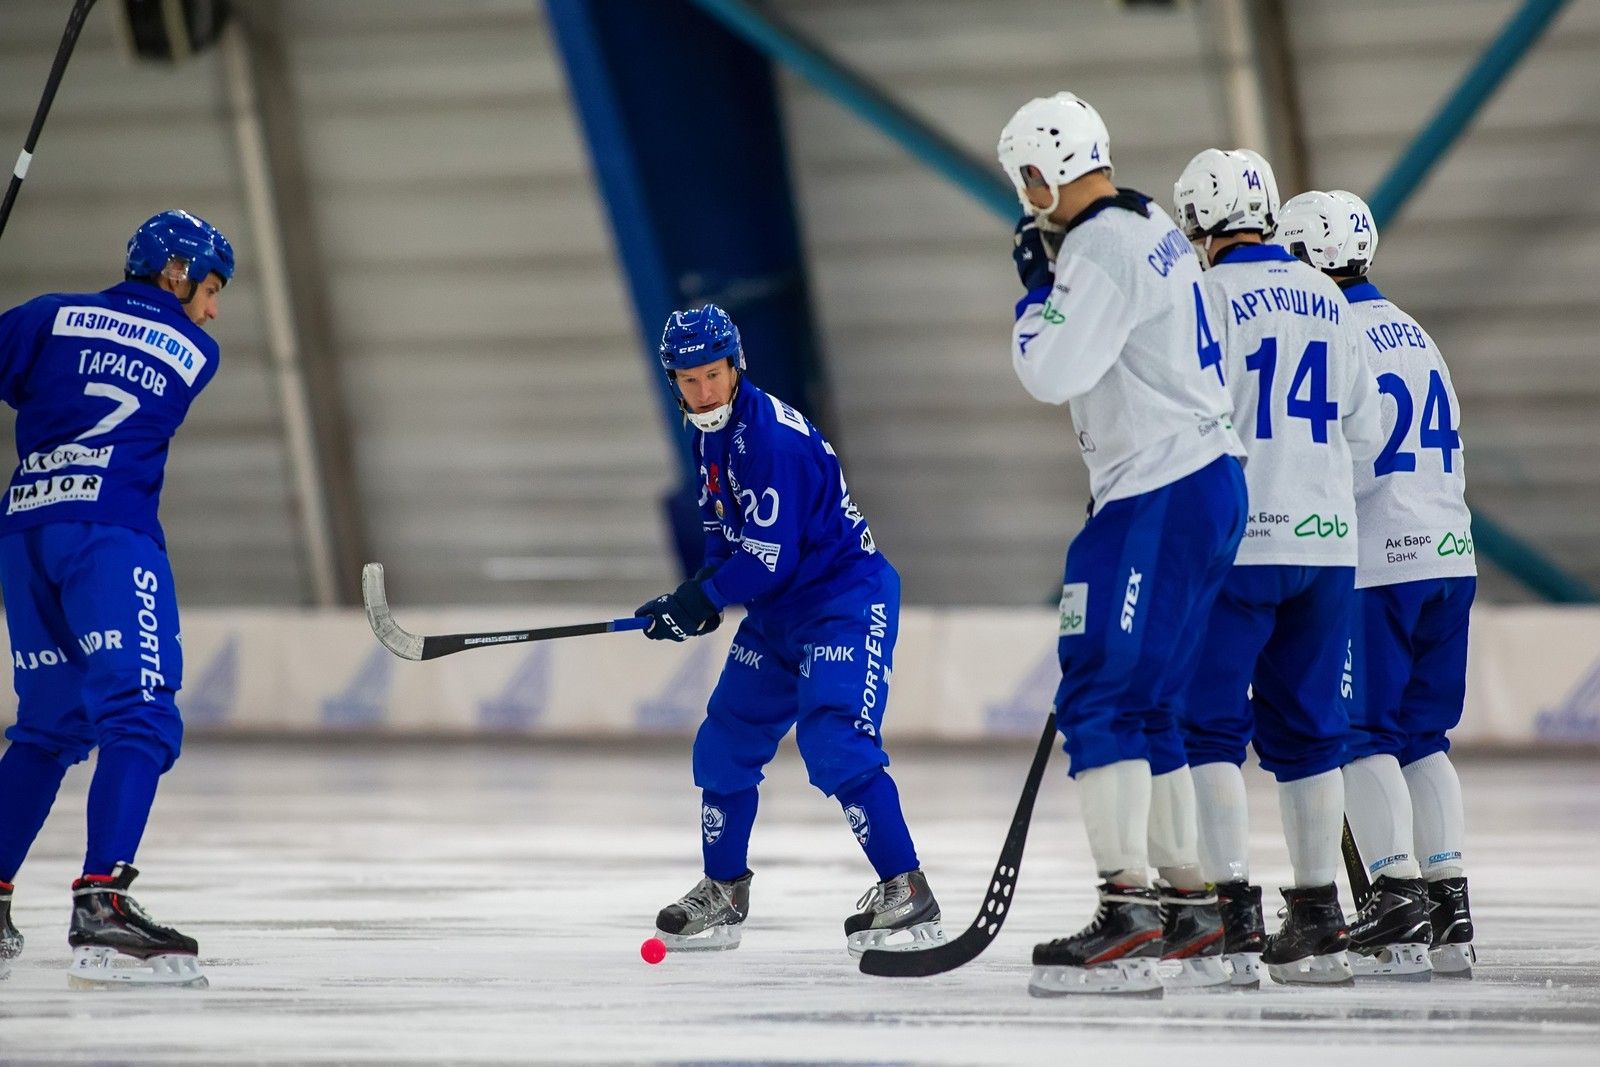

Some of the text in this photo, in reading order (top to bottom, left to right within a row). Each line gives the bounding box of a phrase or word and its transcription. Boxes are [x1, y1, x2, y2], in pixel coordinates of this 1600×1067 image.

[1090, 142, 1100, 162] 4
[1242, 169, 1262, 191] 14
[1284, 228, 1304, 237] CCM
[1349, 212, 1369, 233] 24
[1231, 286, 1339, 326] АРТЮШИН
[66, 311, 194, 371] ГАЗПРОМНЕФТЬ
[678, 343, 706, 354] CCM
[1192, 281, 1226, 387] 4
[1366, 321, 1427, 353] КОРЕВ
[78, 348, 168, 397] ТАРАСОВ
[1245, 336, 1339, 444] 14
[83, 381, 142, 442] 7
[1373, 369, 1461, 478] 24
[12, 476, 99, 503] MAJOR
[1259, 512, 1290, 524] Барс
[1385, 535, 1432, 549] Ак Барс
[1387, 551, 1418, 563] Банк
[1120, 566, 1143, 635] STEX
[133, 566, 166, 703] SPORTE
[728, 643, 764, 670] РМК
[814, 646, 856, 662] РМК
[854, 603, 888, 737] SPORTEWA
